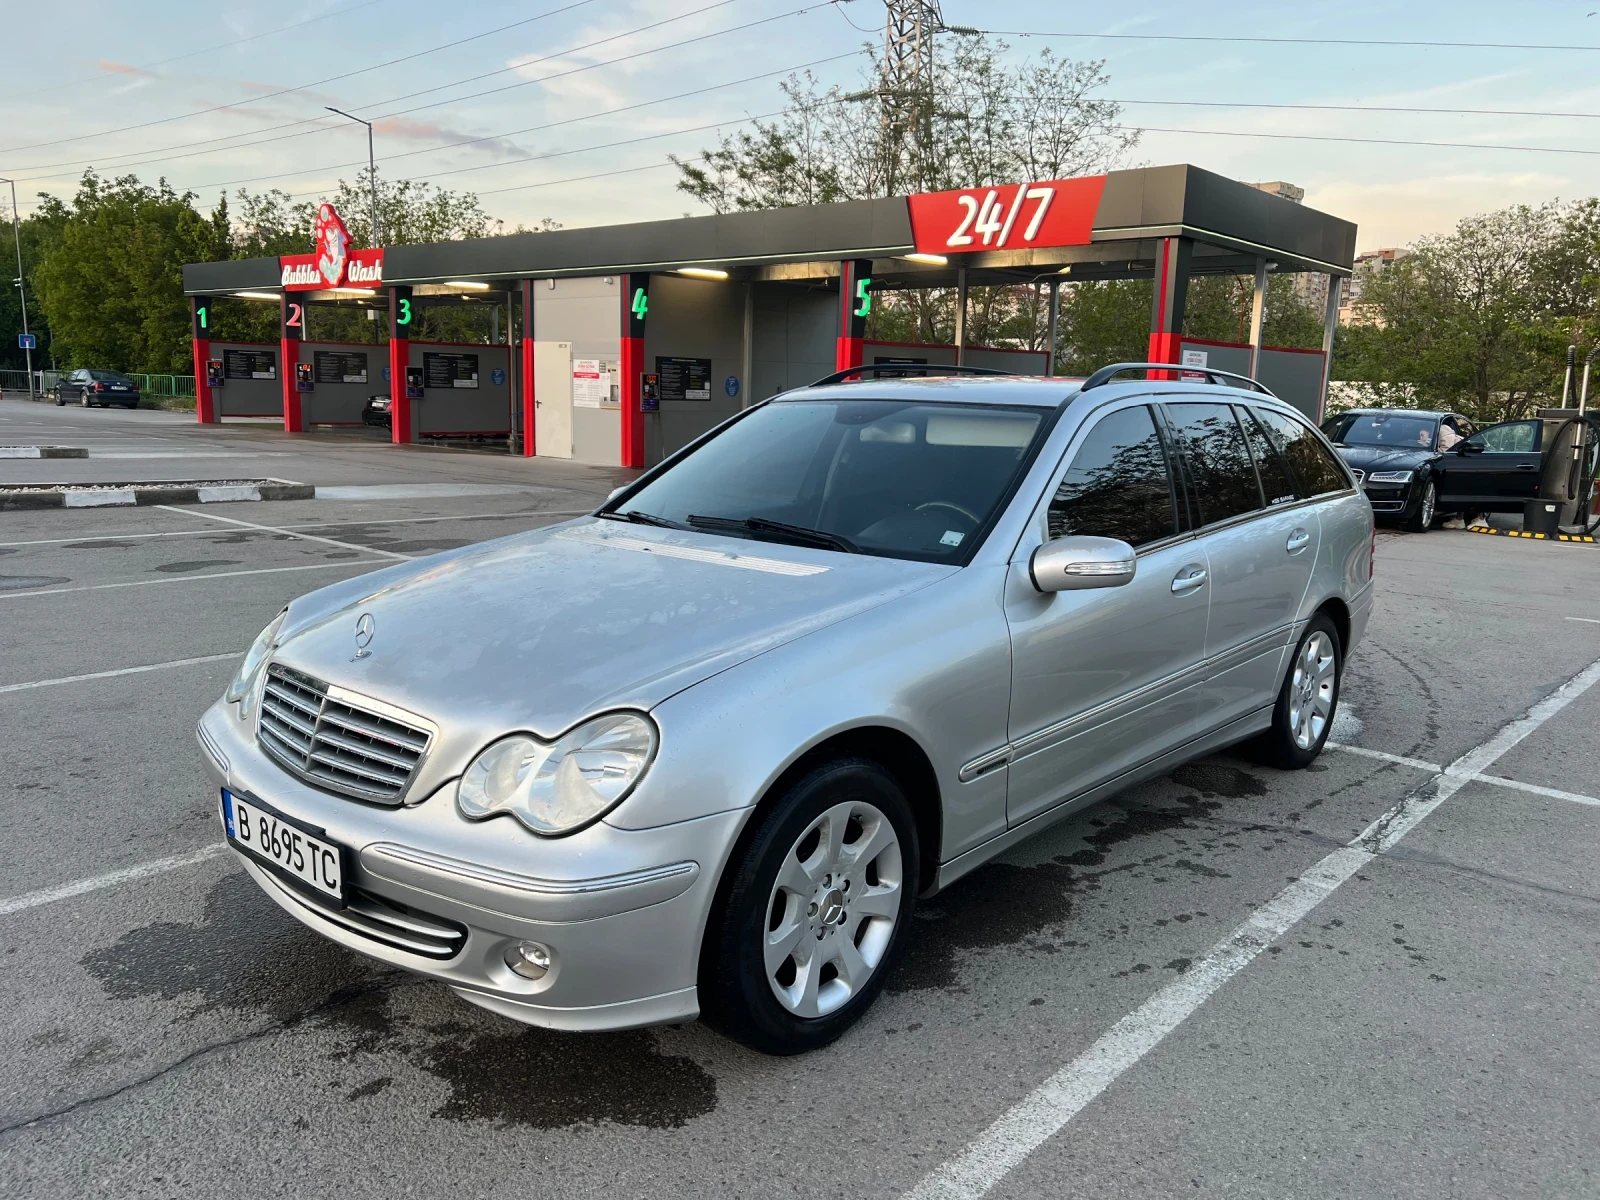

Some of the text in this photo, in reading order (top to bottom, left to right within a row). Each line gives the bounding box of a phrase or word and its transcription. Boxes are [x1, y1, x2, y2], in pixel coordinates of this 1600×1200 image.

[946, 183, 1055, 247] 24/7
[281, 259, 383, 286] Bubbles Wash
[396, 298, 412, 325] 3
[632, 287, 648, 320] 4
[854, 278, 871, 317] 5
[196, 307, 207, 328] 1
[286, 303, 301, 327] 2
[238, 804, 250, 841] B
